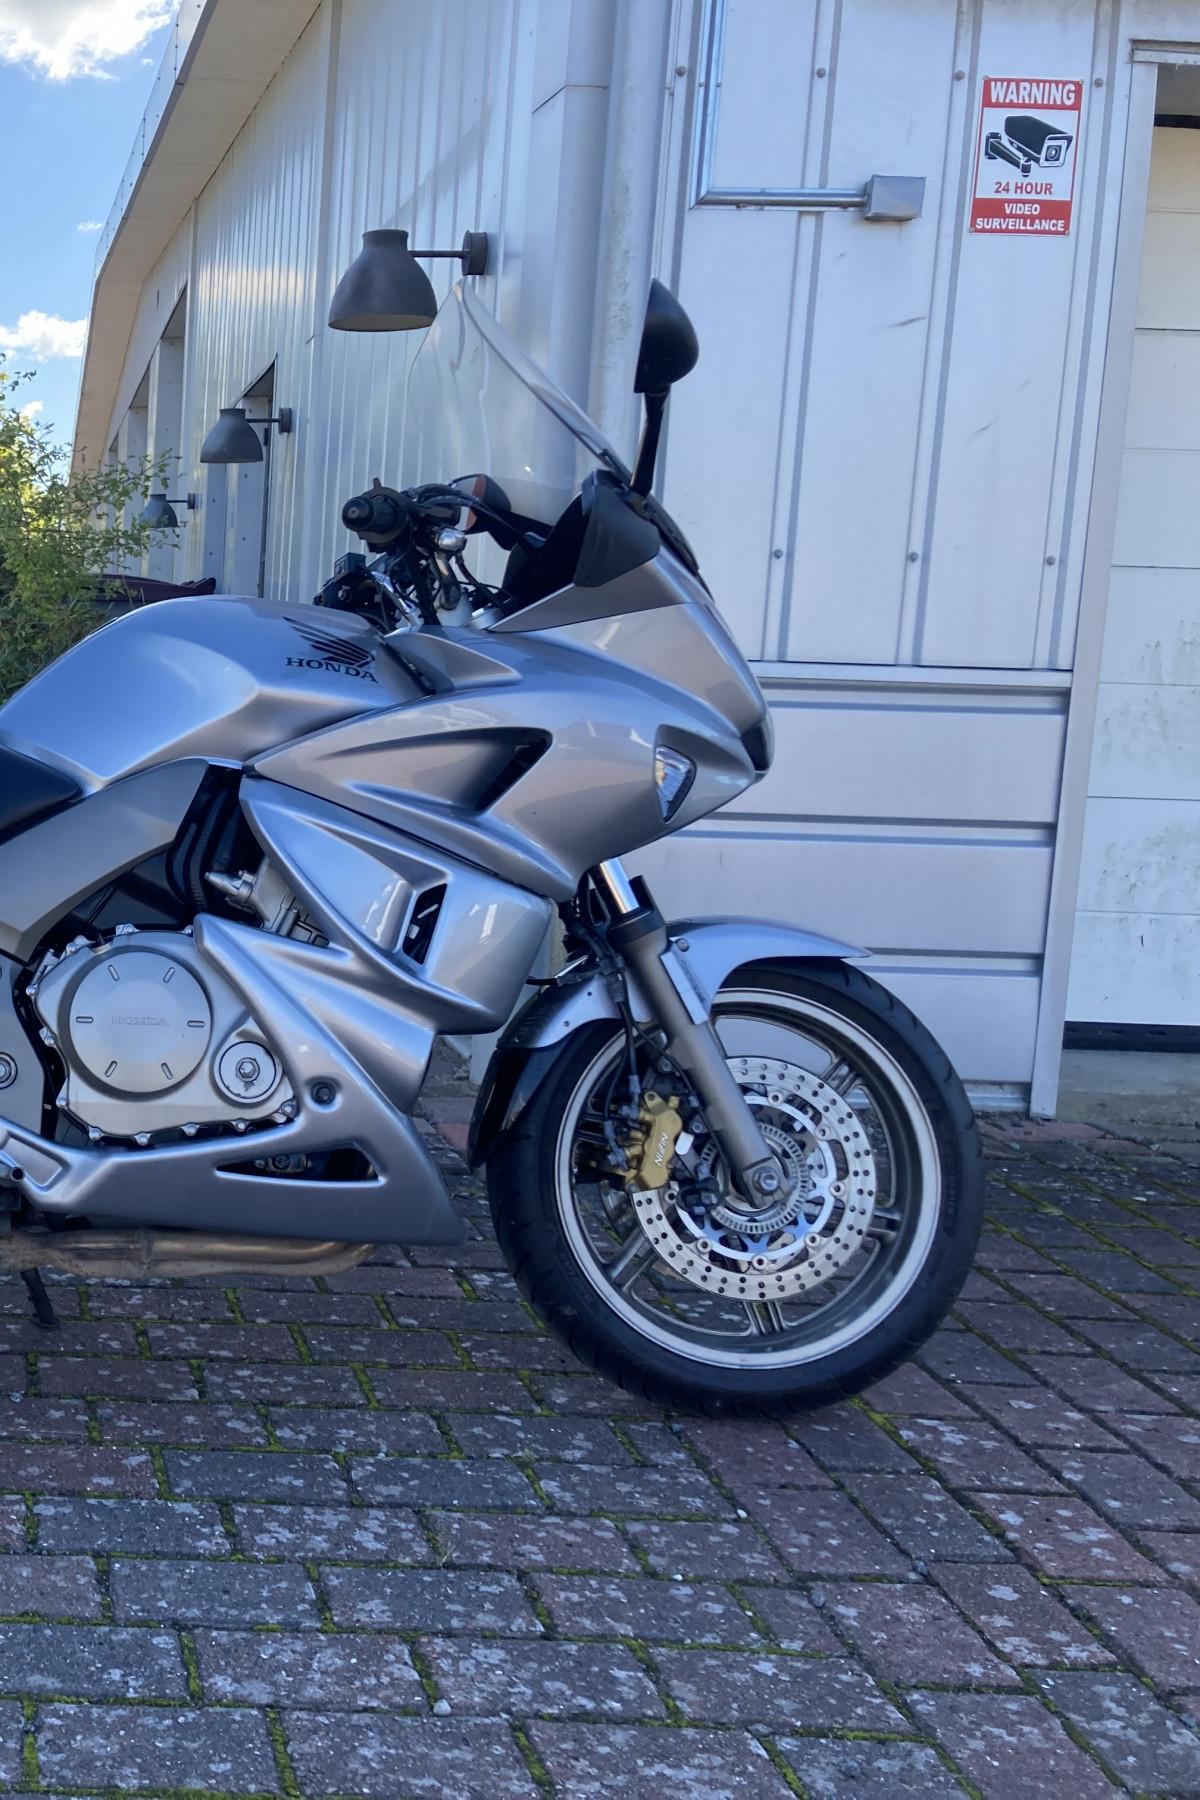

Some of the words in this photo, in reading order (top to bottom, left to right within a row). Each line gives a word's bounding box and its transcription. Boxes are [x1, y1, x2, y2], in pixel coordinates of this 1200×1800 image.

[990, 81, 1075, 106] WARNING
[994, 181, 1010, 194] 24
[1014, 182, 1053, 195] HOUR
[1004, 203, 1041, 215] VIDEO
[975, 218, 1065, 231] SURVEILLANCE
[285, 656, 379, 684] HONDA
